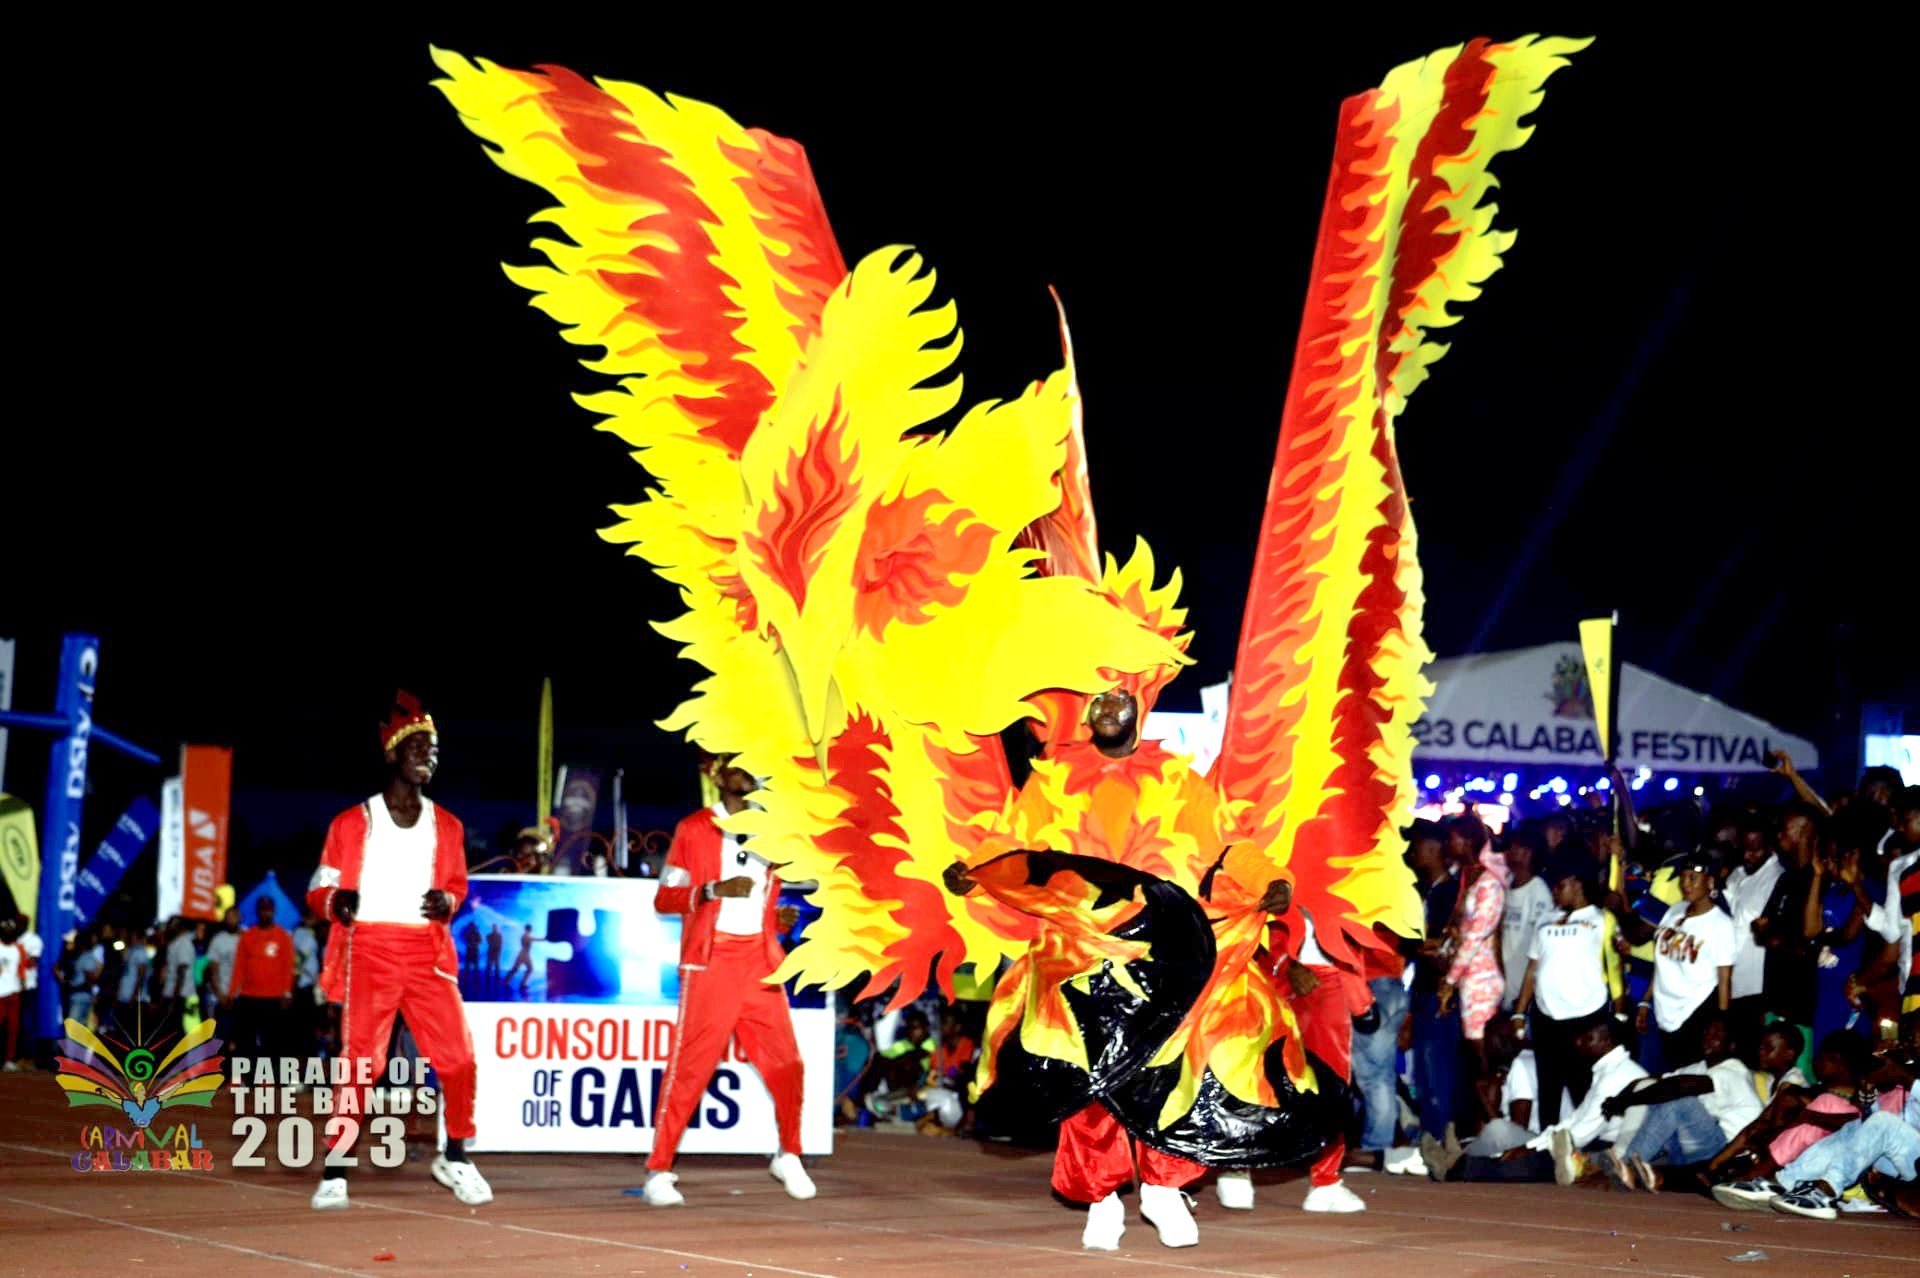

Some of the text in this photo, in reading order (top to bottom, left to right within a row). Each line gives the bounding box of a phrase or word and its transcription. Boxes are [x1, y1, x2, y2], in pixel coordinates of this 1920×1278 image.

[1463, 719, 1622, 759] CALABA
[191, 845, 216, 911] UBA
[495, 1017, 749, 1063] CONSOLID
[533, 1070, 563, 1097] OF
[522, 1100, 561, 1127] OUR
